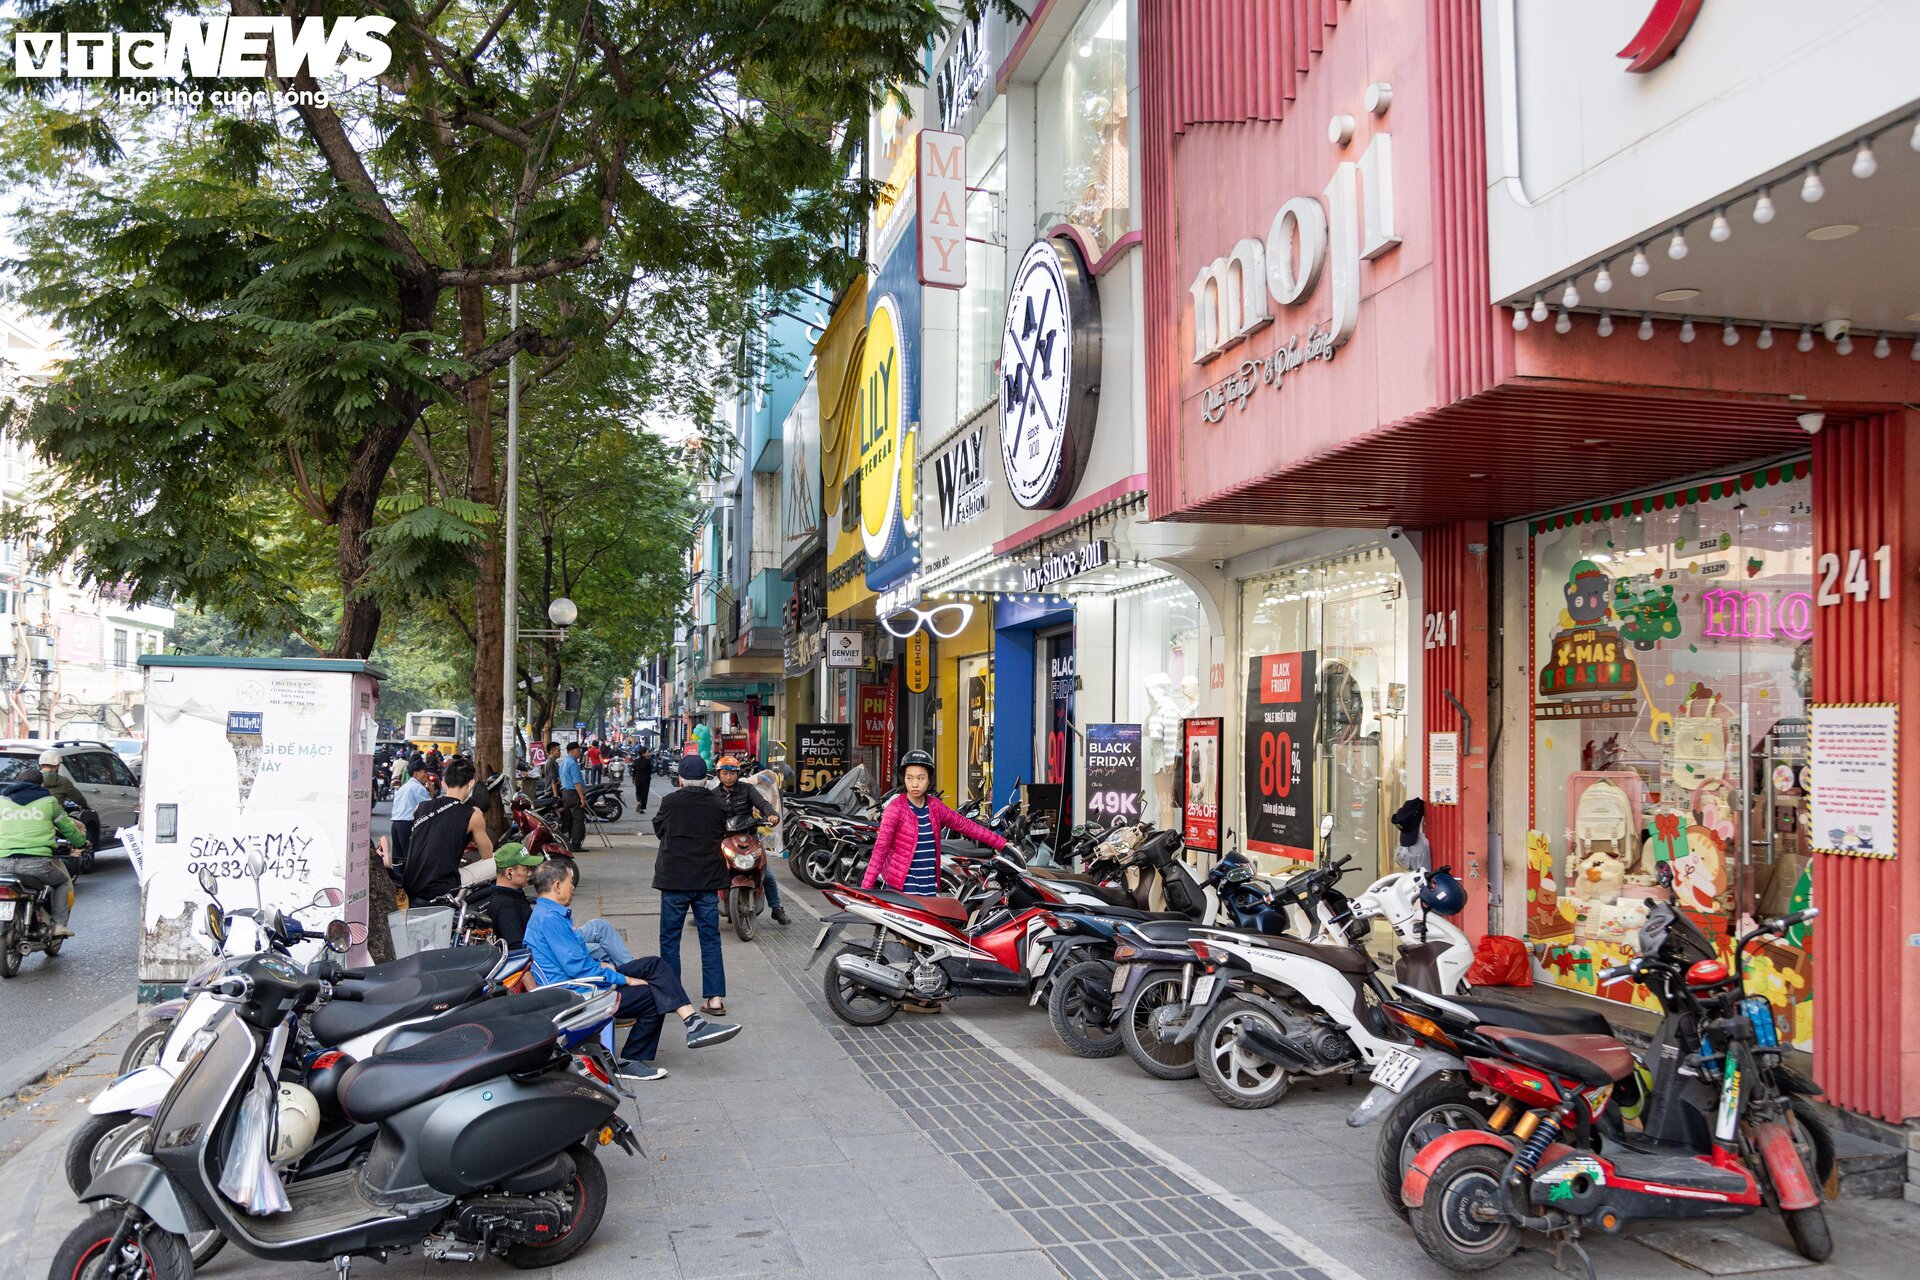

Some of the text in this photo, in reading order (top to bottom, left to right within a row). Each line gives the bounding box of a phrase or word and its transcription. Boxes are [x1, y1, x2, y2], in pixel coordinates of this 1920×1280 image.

[926, 142, 962, 272] MAY
[1188, 82, 1402, 364] moji
[860, 346, 894, 457] LILY
[1079, 541, 1103, 572] 2011
[1669, 571, 1678, 580] 23
[1817, 544, 1891, 607] 241
[1424, 609, 1457, 650] 241
[1573, 630, 1596, 643] moji
[1557, 642, 1616, 667] X-MAS
[1272, 662, 1290, 677] BLACK
[1543, 662, 1632, 689] TREASURE
[1271, 678, 1291, 694] FRIDAY
[864, 698, 886, 713] PH
[1264, 712, 1274, 722] SALE
[802, 738, 844, 746] BLACK
[1089, 742, 1132, 754] BLACK
[802, 747, 844, 755] FRIDAY
[1048, 731, 1065, 785] 90
[806, 758, 840, 766] SALE
[1089, 756, 1136, 767] FRIDAY
[1260, 731, 1291, 798] 80
[1291, 751, 1300, 774] %
[1089, 792, 1138, 814] 49K
[1188, 802, 1216, 818] 25% OFF
[2, 807, 44, 820] Grab
[264, 826, 314, 860] MÁY
[1247, 949, 1287, 962] VISION
